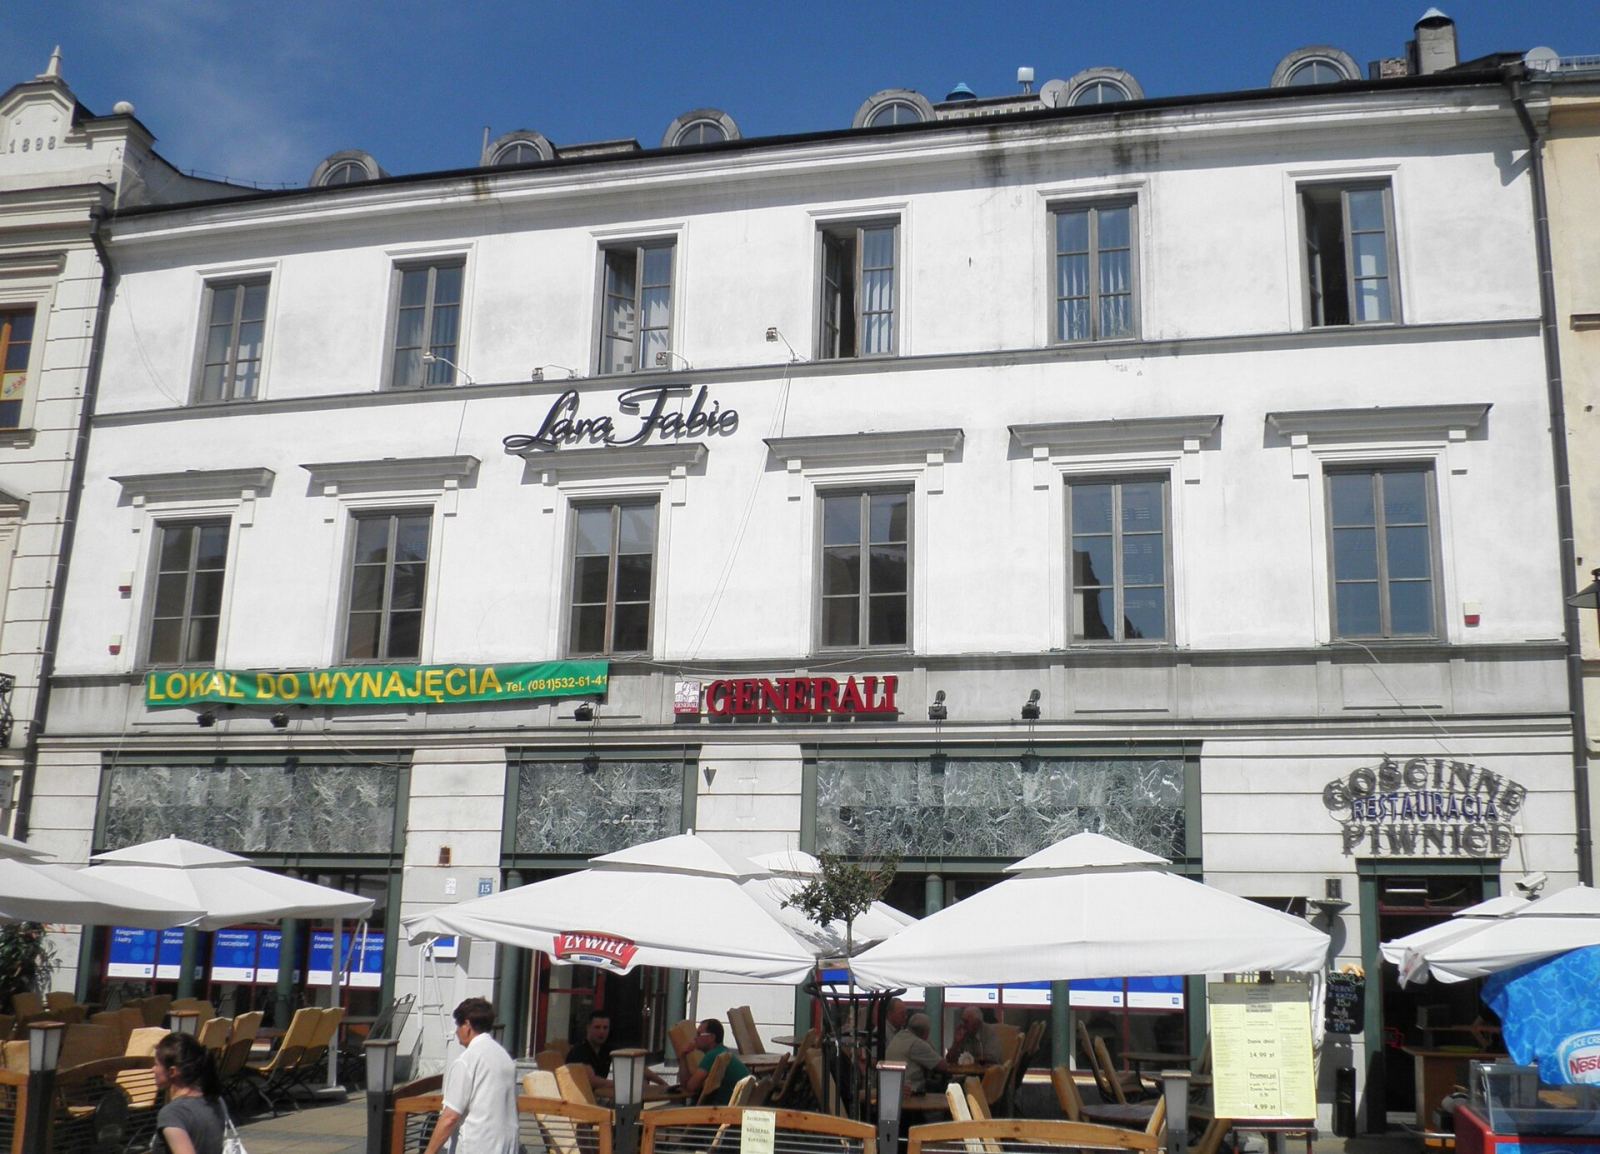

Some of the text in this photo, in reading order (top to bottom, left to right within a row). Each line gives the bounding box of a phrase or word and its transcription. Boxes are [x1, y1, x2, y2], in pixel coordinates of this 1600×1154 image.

[9, 136, 56, 154] 1898
[503, 383, 738, 449] Lara Fabio
[149, 671, 245, 700] LOKAL
[256, 673, 299, 699] DO
[308, 667, 503, 703] WYNAJĘCIA
[505, 681, 525, 692] Tel.
[706, 676, 898, 716] GENERALI
[1323, 752, 1528, 816] GOŚCINNE
[1342, 823, 1513, 856] PIWNICE
[480, 884, 490, 893] 15
